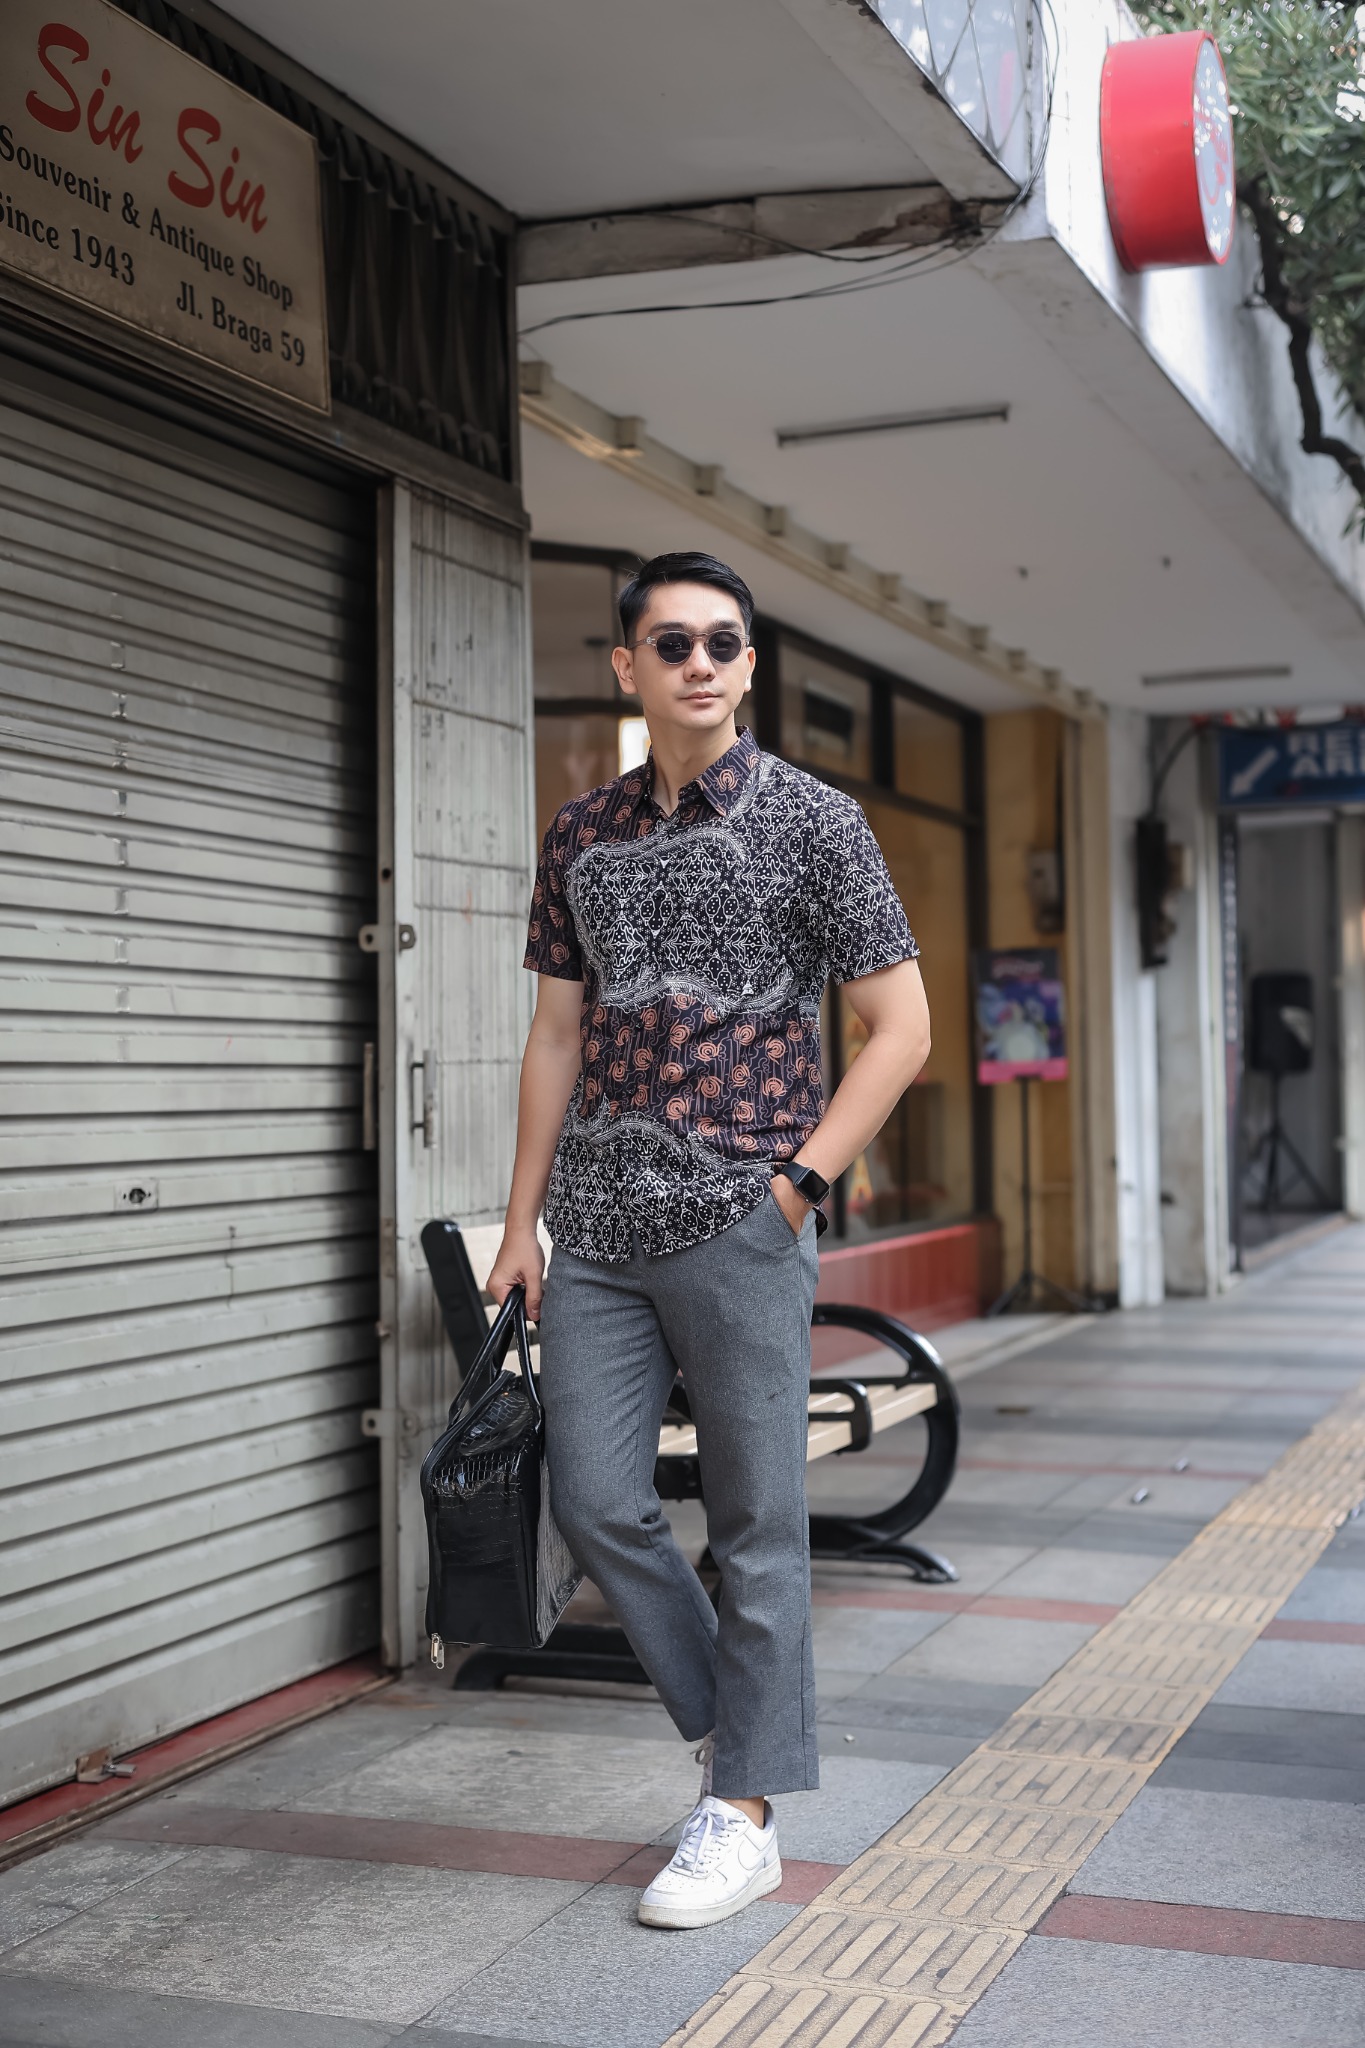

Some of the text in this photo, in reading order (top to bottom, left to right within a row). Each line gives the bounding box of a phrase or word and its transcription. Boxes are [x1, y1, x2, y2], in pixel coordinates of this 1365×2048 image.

[26, 23, 267, 234] Sin Sin
[0, 124, 293, 312] Souvenir & Antique Shop
[71, 228, 136, 287] 1943
[176, 280, 306, 368] Jl. Braga 59
